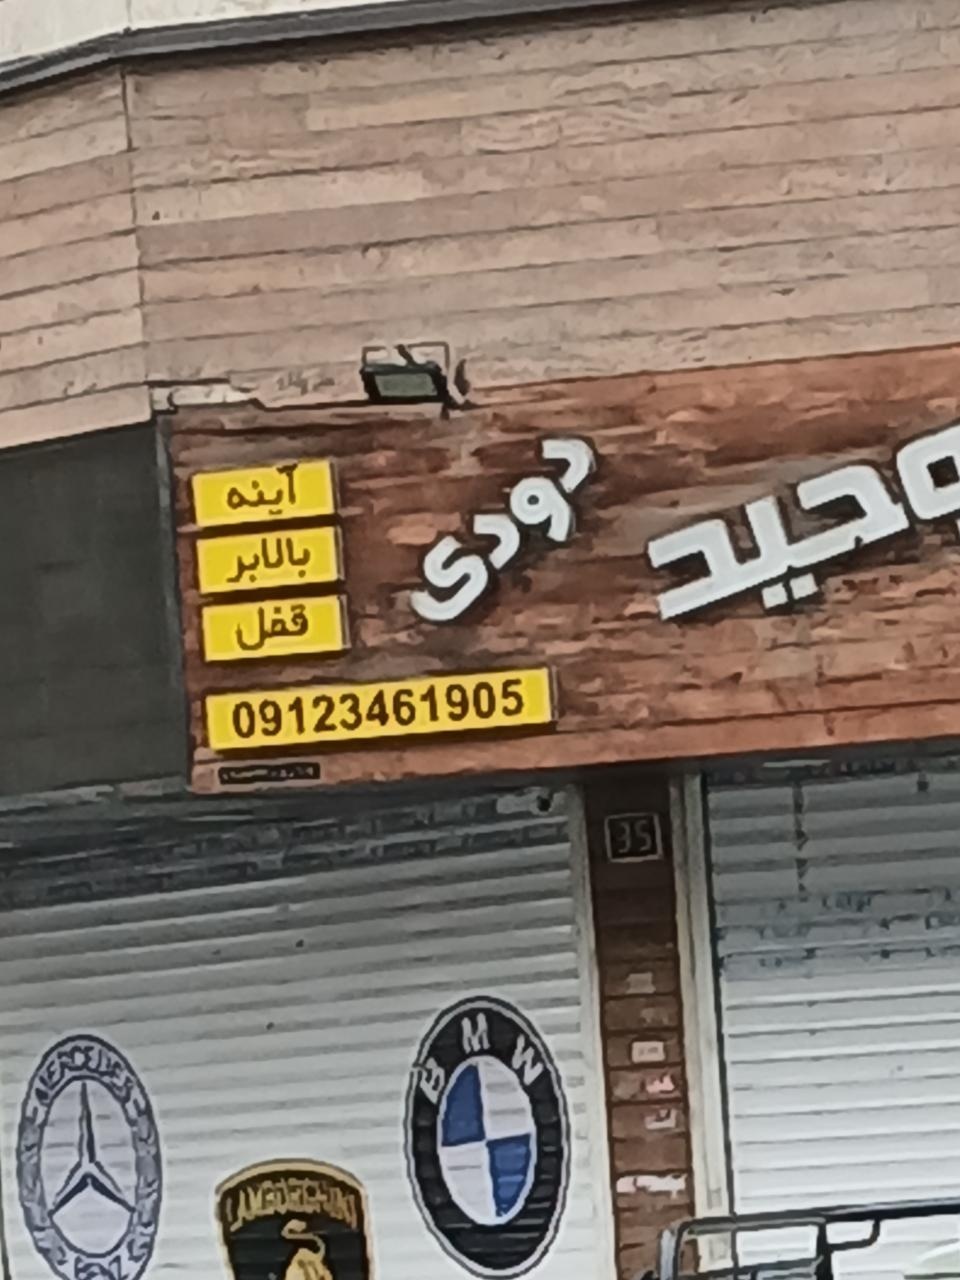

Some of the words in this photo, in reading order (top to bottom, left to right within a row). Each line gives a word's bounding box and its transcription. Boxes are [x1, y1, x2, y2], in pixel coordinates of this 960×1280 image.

[227, 464, 298, 515] آینه
[410, 438, 595, 621] دودی
[226, 537, 312, 583] بالابر
[235, 604, 309, 651] قفل
[231, 678, 526, 739] 09123461905
[616, 820, 652, 853] 35
[419, 1012, 544, 1105] BMW
